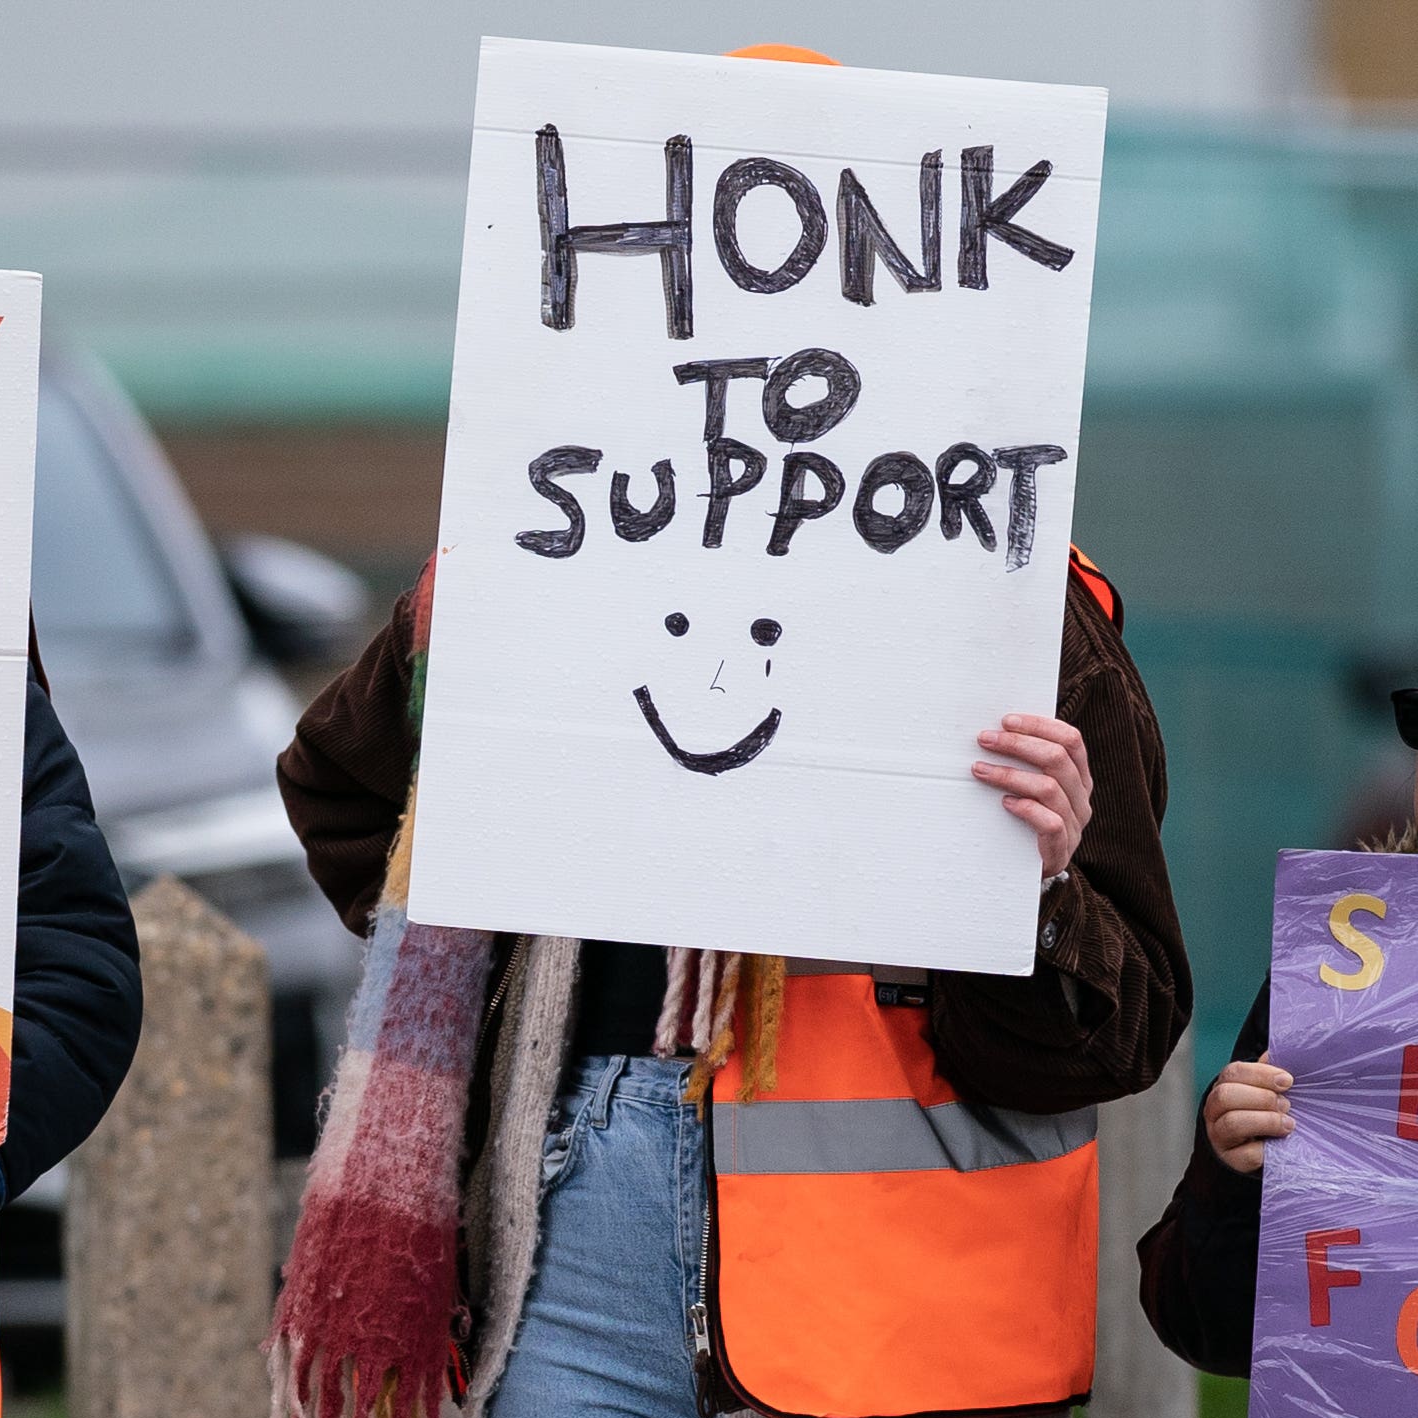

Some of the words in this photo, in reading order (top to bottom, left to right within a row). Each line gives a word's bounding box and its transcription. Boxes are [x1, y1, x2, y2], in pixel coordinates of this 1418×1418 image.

[535, 123, 1075, 341] HONK
[673, 347, 862, 443] TO
[516, 437, 1068, 573] SUPPORT
